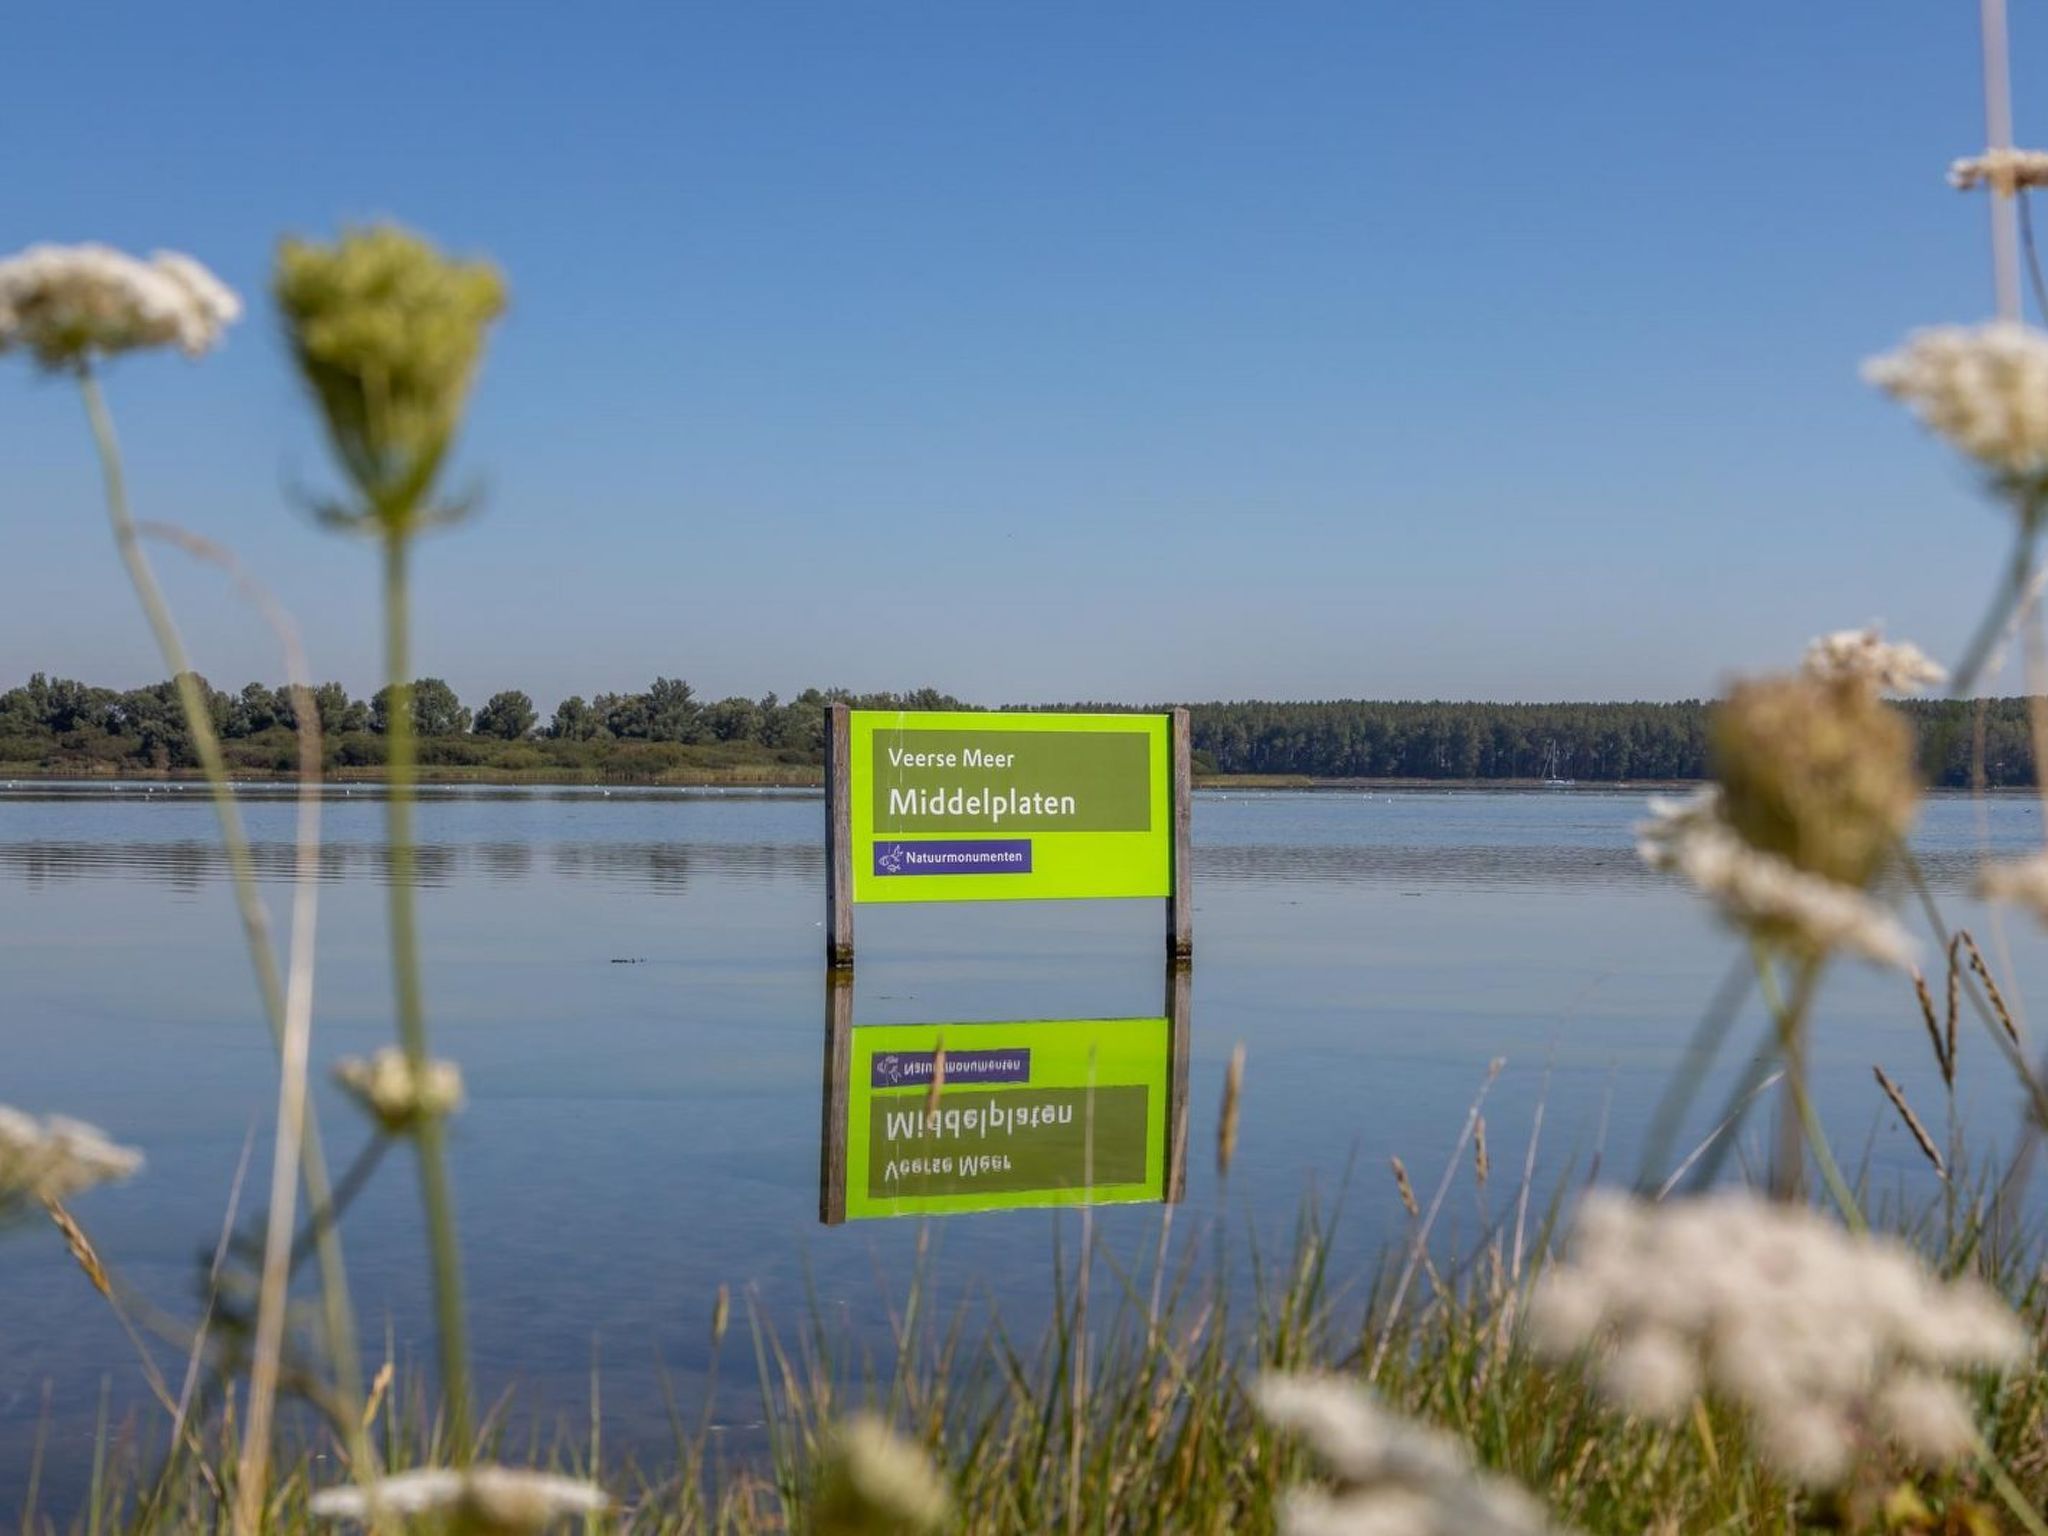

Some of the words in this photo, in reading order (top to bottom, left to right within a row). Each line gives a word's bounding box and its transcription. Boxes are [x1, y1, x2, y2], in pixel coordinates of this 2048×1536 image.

[888, 748, 957, 767] Veerse
[963, 749, 1014, 767] Meer
[889, 788, 1075, 823] Middelplaten
[906, 850, 1023, 864] Natuurmonumenten
